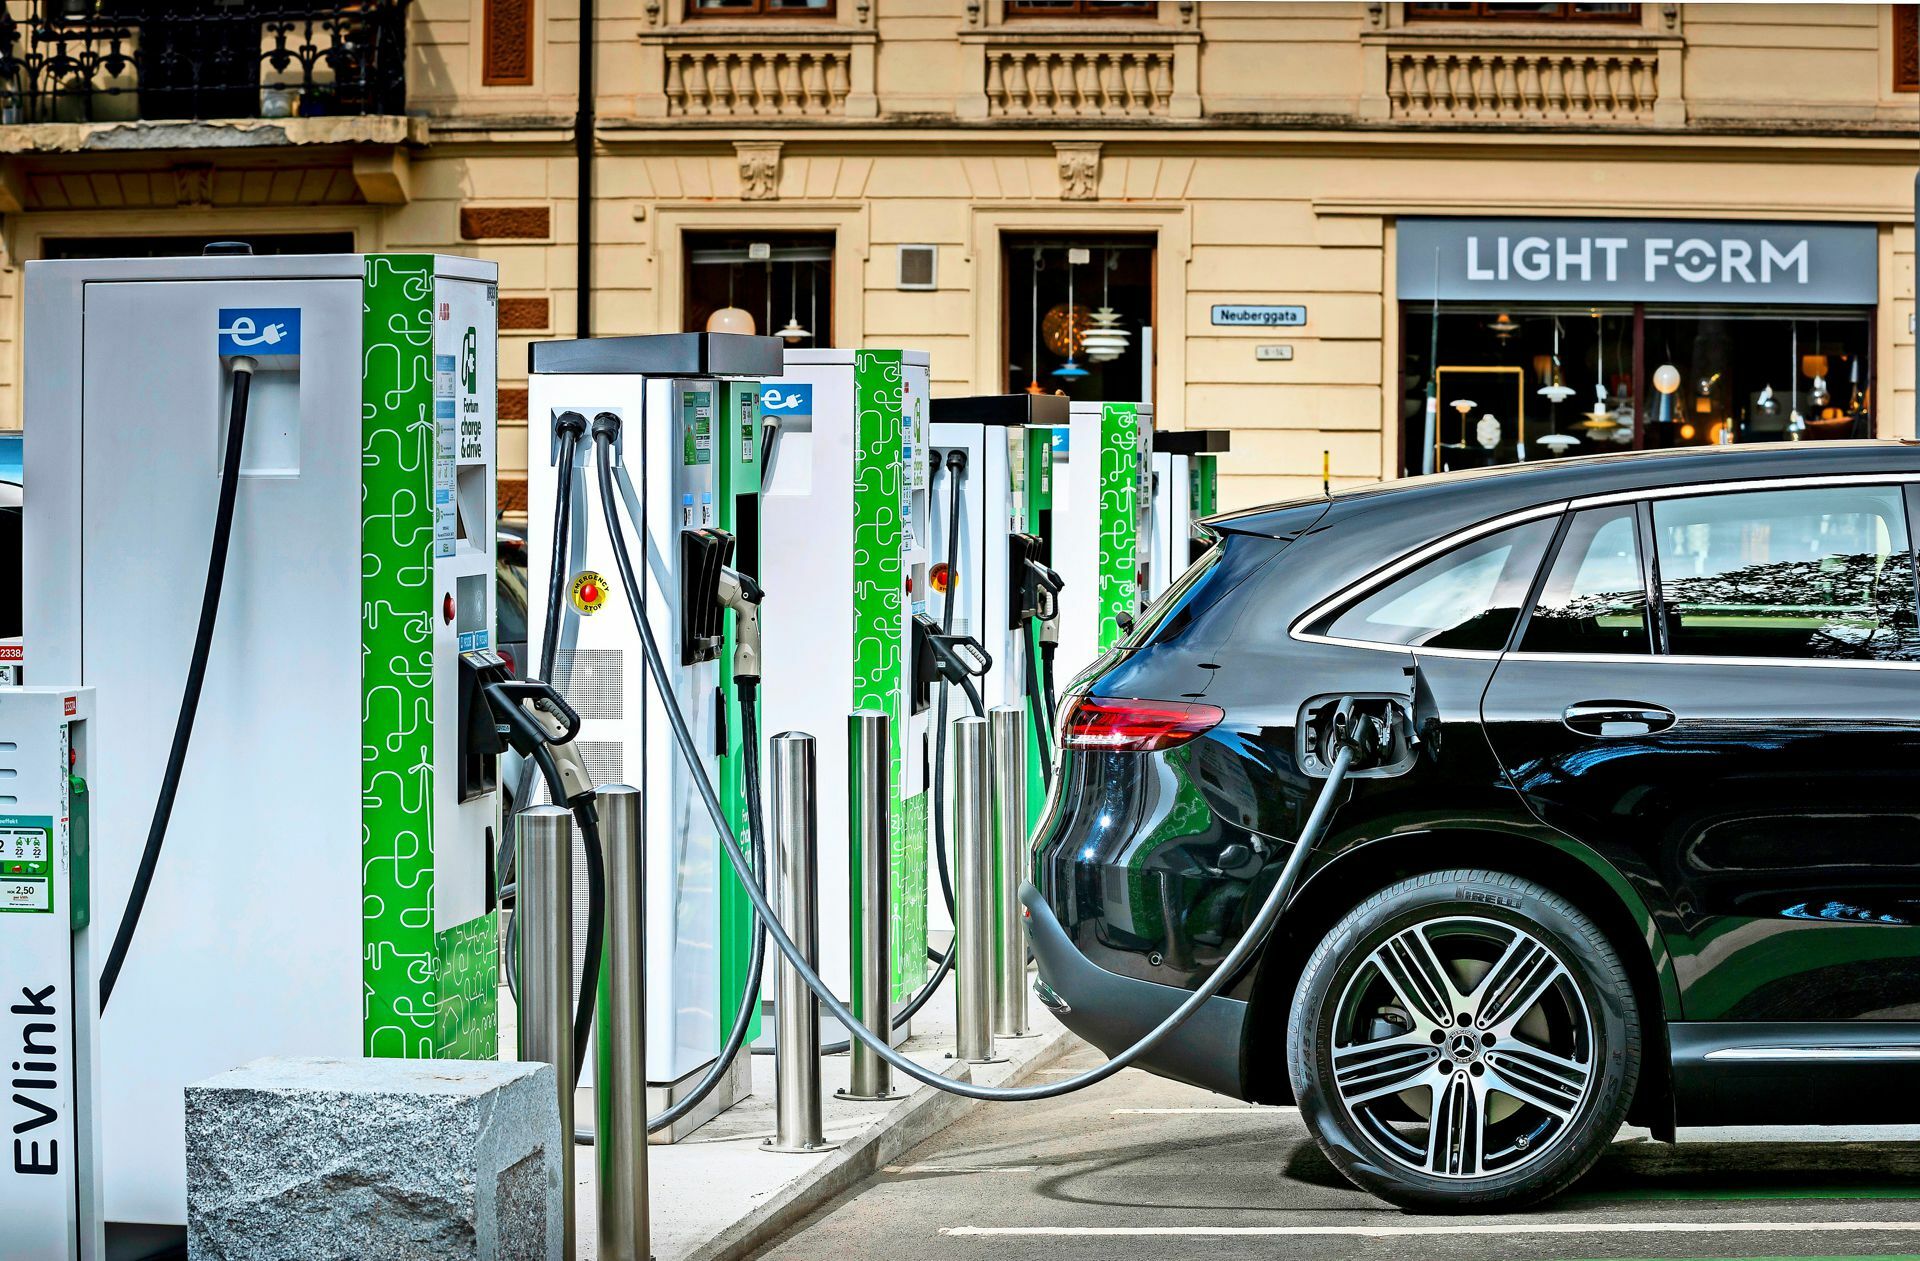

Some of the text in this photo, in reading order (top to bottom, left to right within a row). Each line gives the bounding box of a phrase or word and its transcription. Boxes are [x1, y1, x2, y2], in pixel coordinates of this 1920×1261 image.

[1466, 236, 1808, 284] LIGHT FORM
[1220, 309, 1297, 325] Neuberggata
[463, 397, 479, 413] Fortum
[460, 416, 482, 442] charge
[460, 437, 466, 459] &
[466, 440, 482, 459] drive
[573, 574, 610, 594] EMERGENCY
[583, 603, 602, 611] STOP
[33, 848, 41, 856] 22
[15, 886, 35, 895] 2,50
[11, 984, 58, 1175] EVlink
